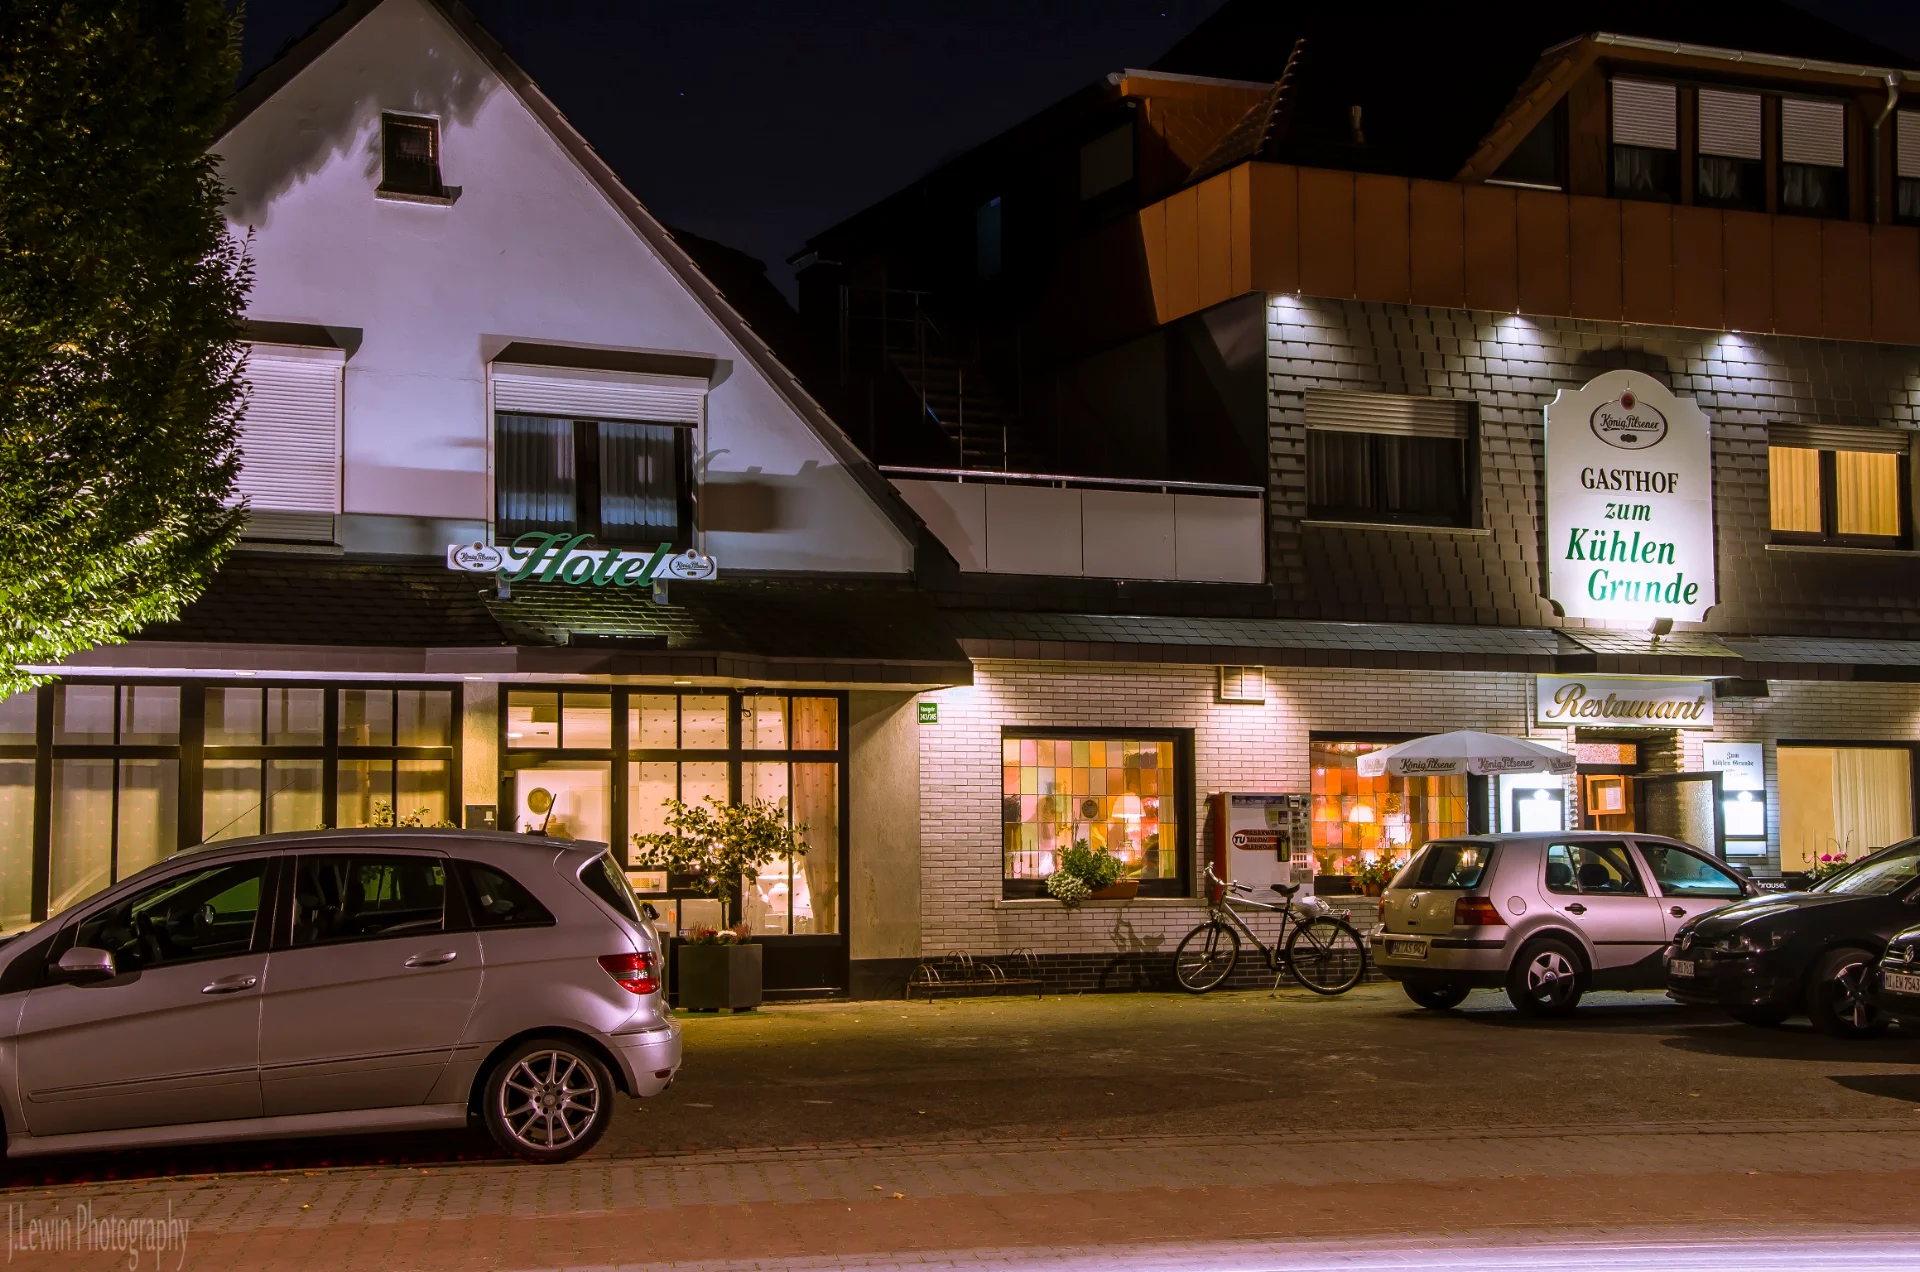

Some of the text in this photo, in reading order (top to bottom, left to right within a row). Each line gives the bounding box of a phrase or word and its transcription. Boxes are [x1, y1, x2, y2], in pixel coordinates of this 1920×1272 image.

[1600, 413, 1660, 430] König Pilsener
[1580, 467, 1679, 494] GASTHOF
[1604, 502, 1651, 522] zum
[1565, 528, 1676, 565] Kühlen
[460, 552, 477, 562] König
[498, 531, 672, 587] Hotel
[1588, 568, 1699, 606] Grunde
[1546, 683, 1706, 721] Restaurant
[1399, 758, 1457, 771] König Pilsener
[1478, 756, 1535, 770] König Pilsener
[1233, 835, 1246, 844] TU
